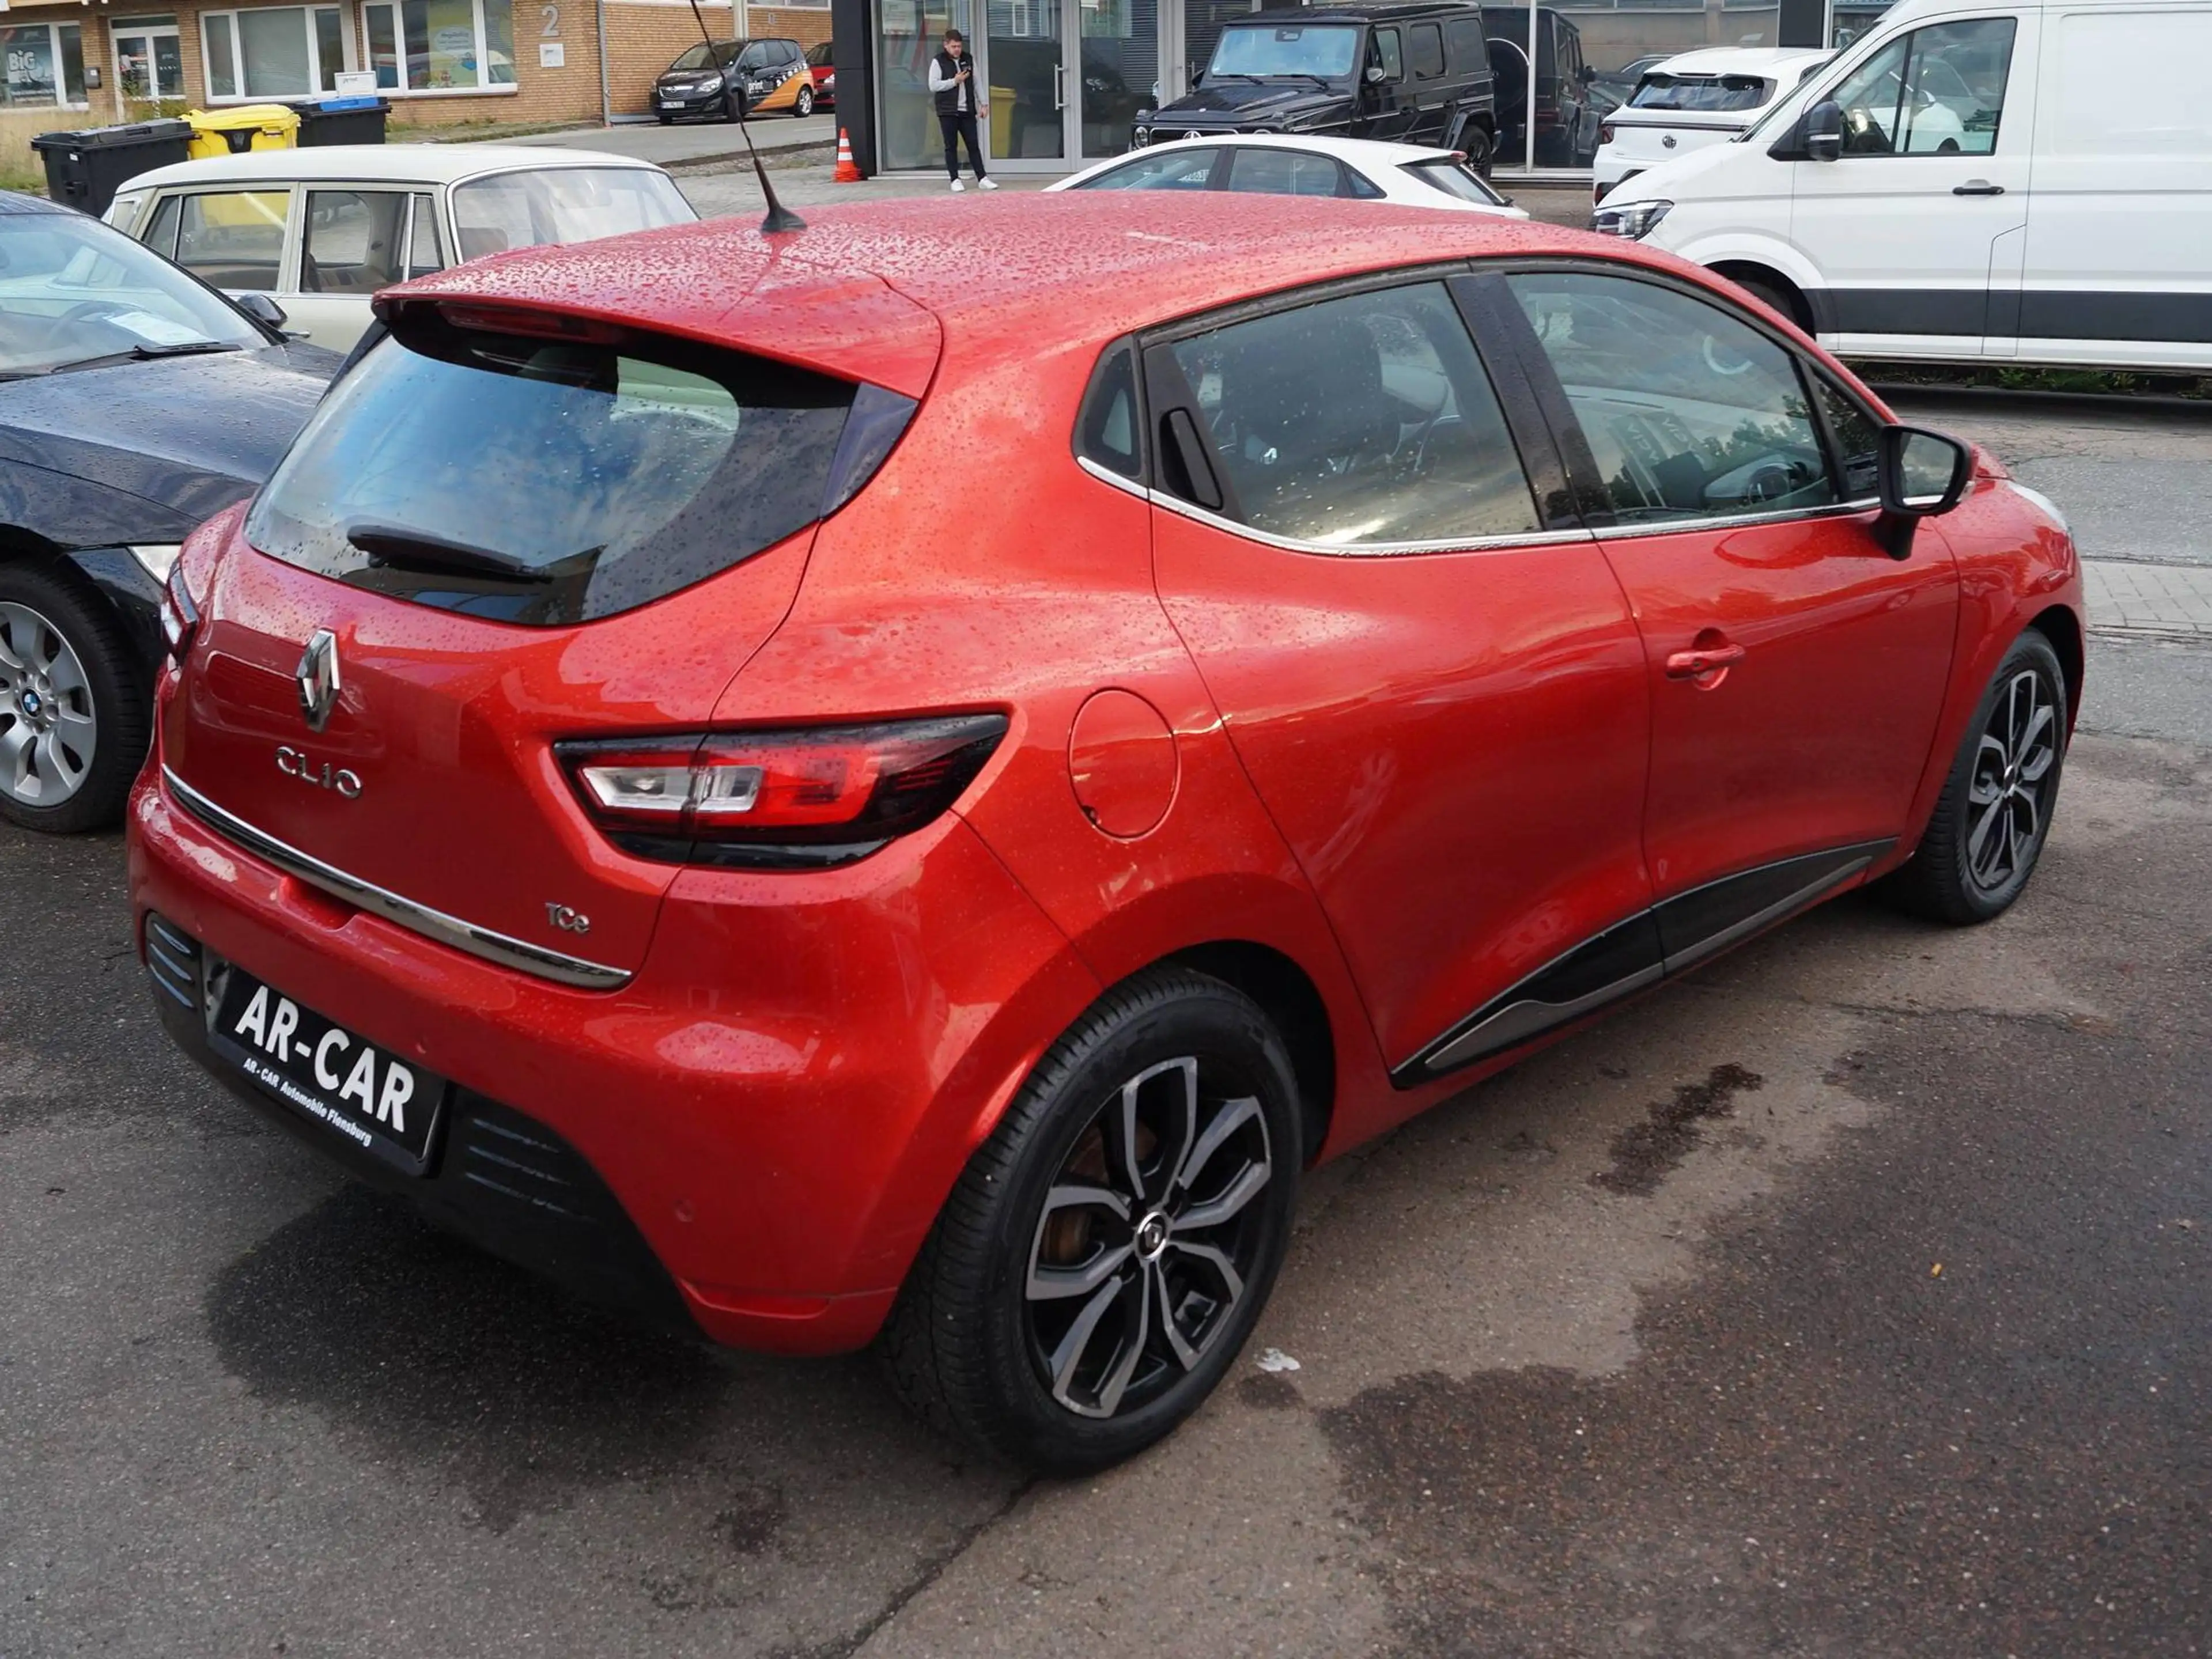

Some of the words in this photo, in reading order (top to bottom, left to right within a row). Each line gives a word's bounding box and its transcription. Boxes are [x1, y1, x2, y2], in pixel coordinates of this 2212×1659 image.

[541, 5, 560, 36] 2
[275, 746, 362, 799] CLIO
[545, 902, 591, 934] TCe
[235, 985, 414, 1132] AR-CAR
[279, 1081, 328, 1118] Automobile
[326, 1108, 372, 1147] Flensburg
